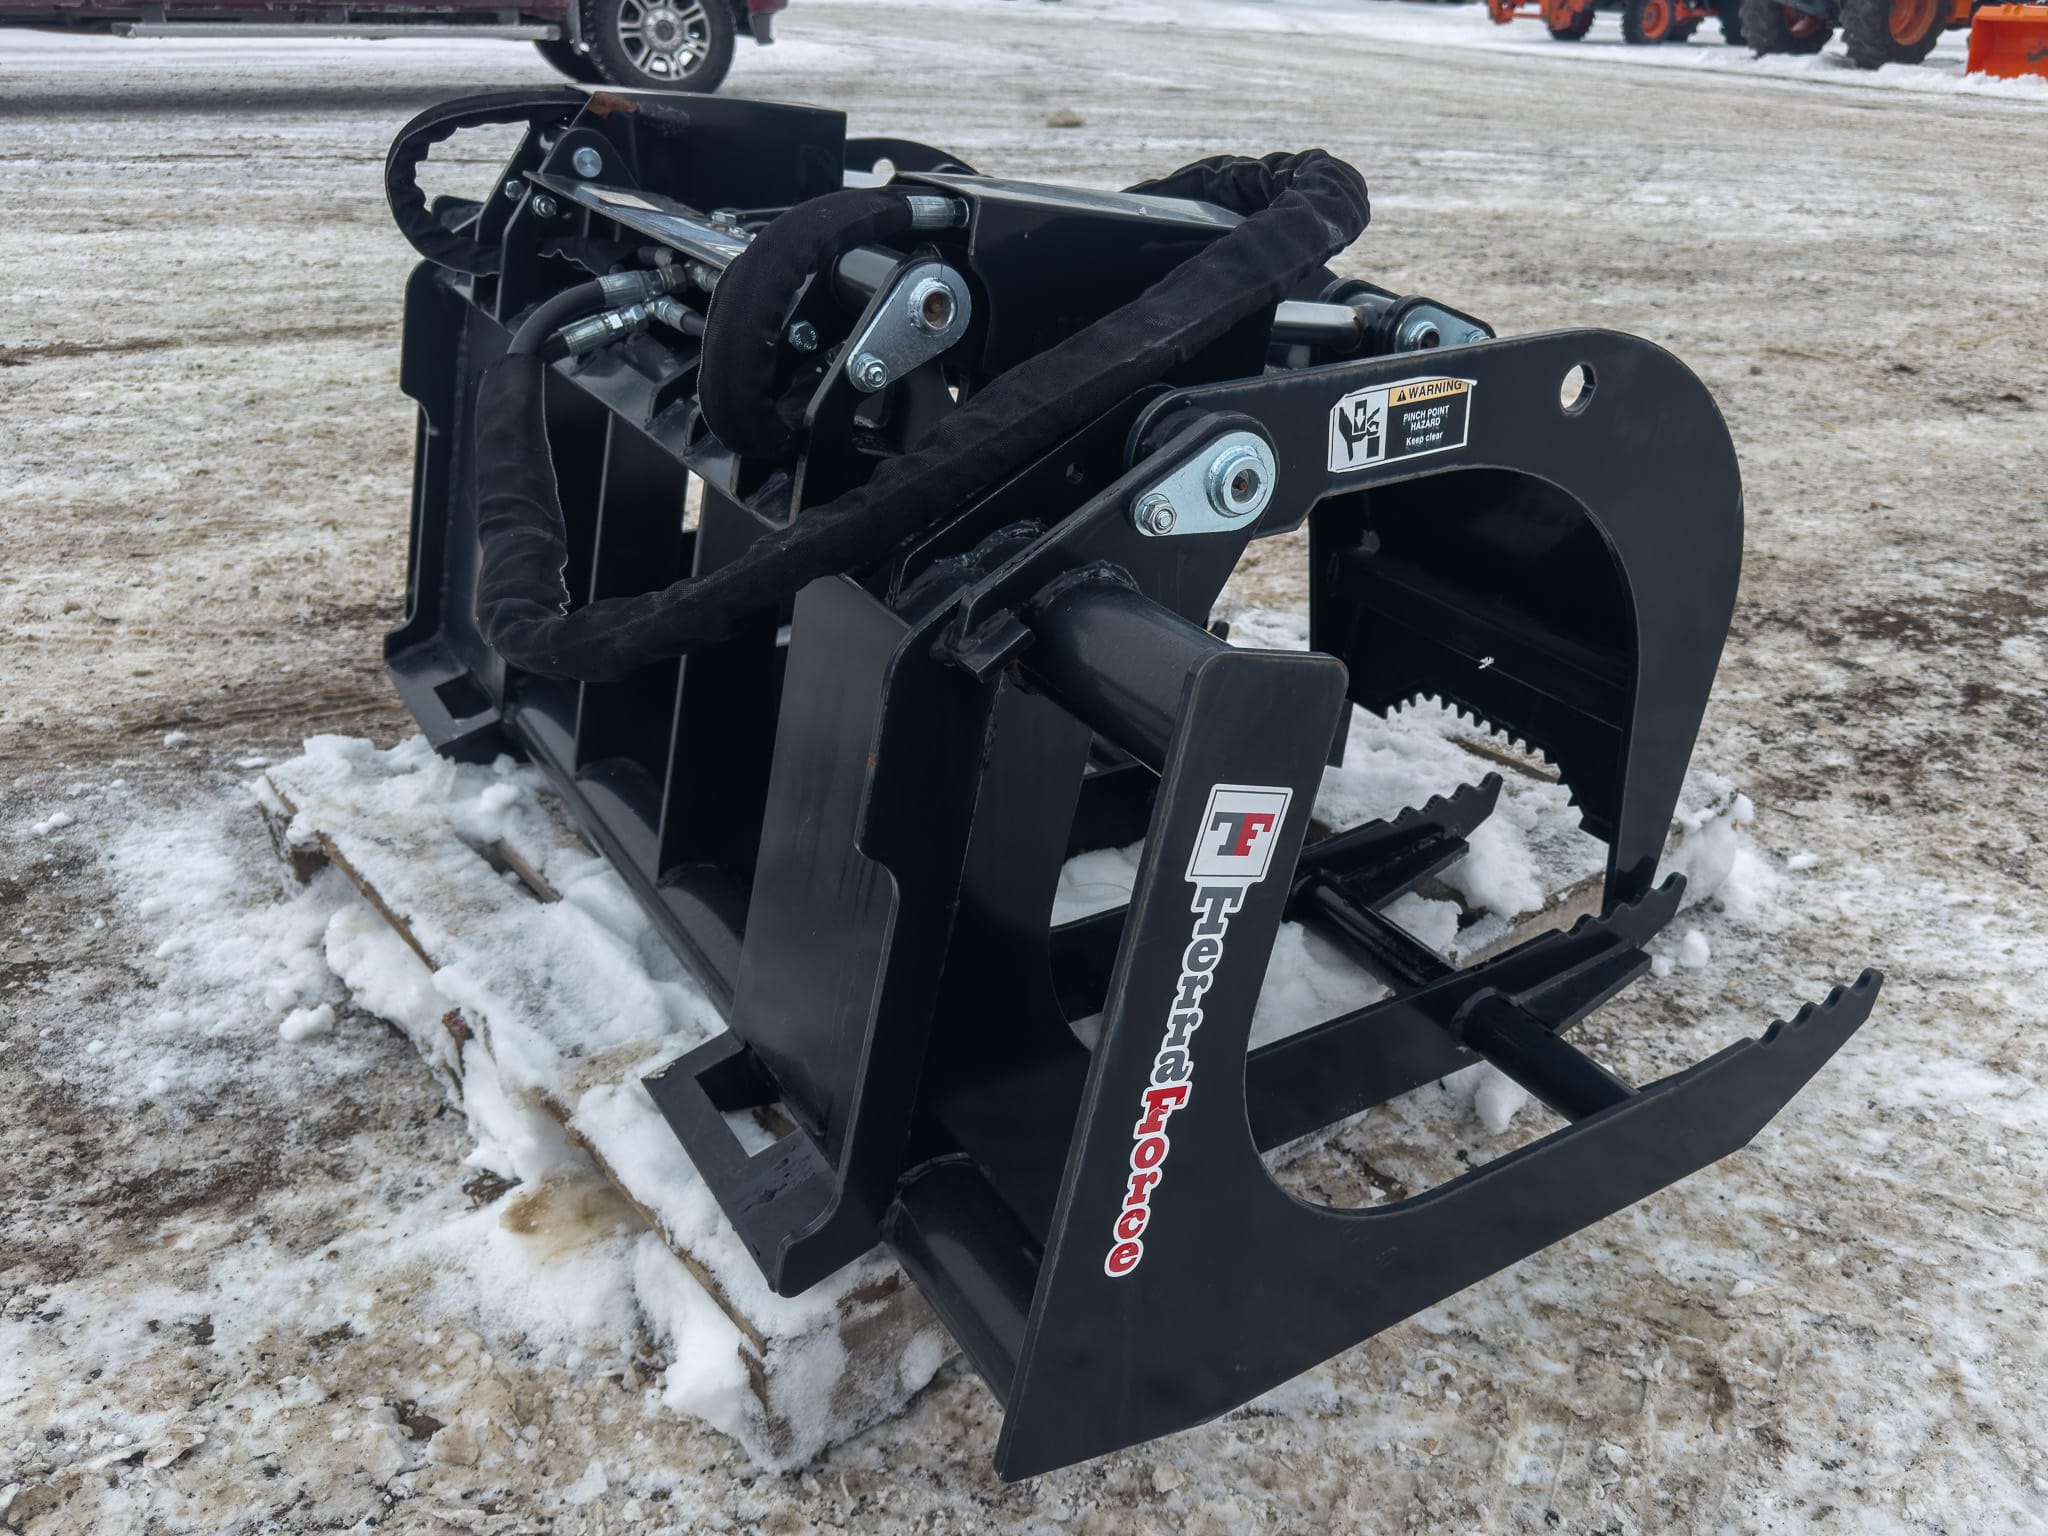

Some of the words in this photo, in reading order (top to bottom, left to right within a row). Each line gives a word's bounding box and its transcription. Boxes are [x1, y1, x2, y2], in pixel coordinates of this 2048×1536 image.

[1408, 380, 1462, 399] WARNING
[1402, 410, 1426, 423] PINCH
[1427, 405, 1450, 418] POINT
[1410, 418, 1441, 431] HAZARD
[1406, 436, 1424, 446] Keep
[1425, 432, 1443, 442] clear
